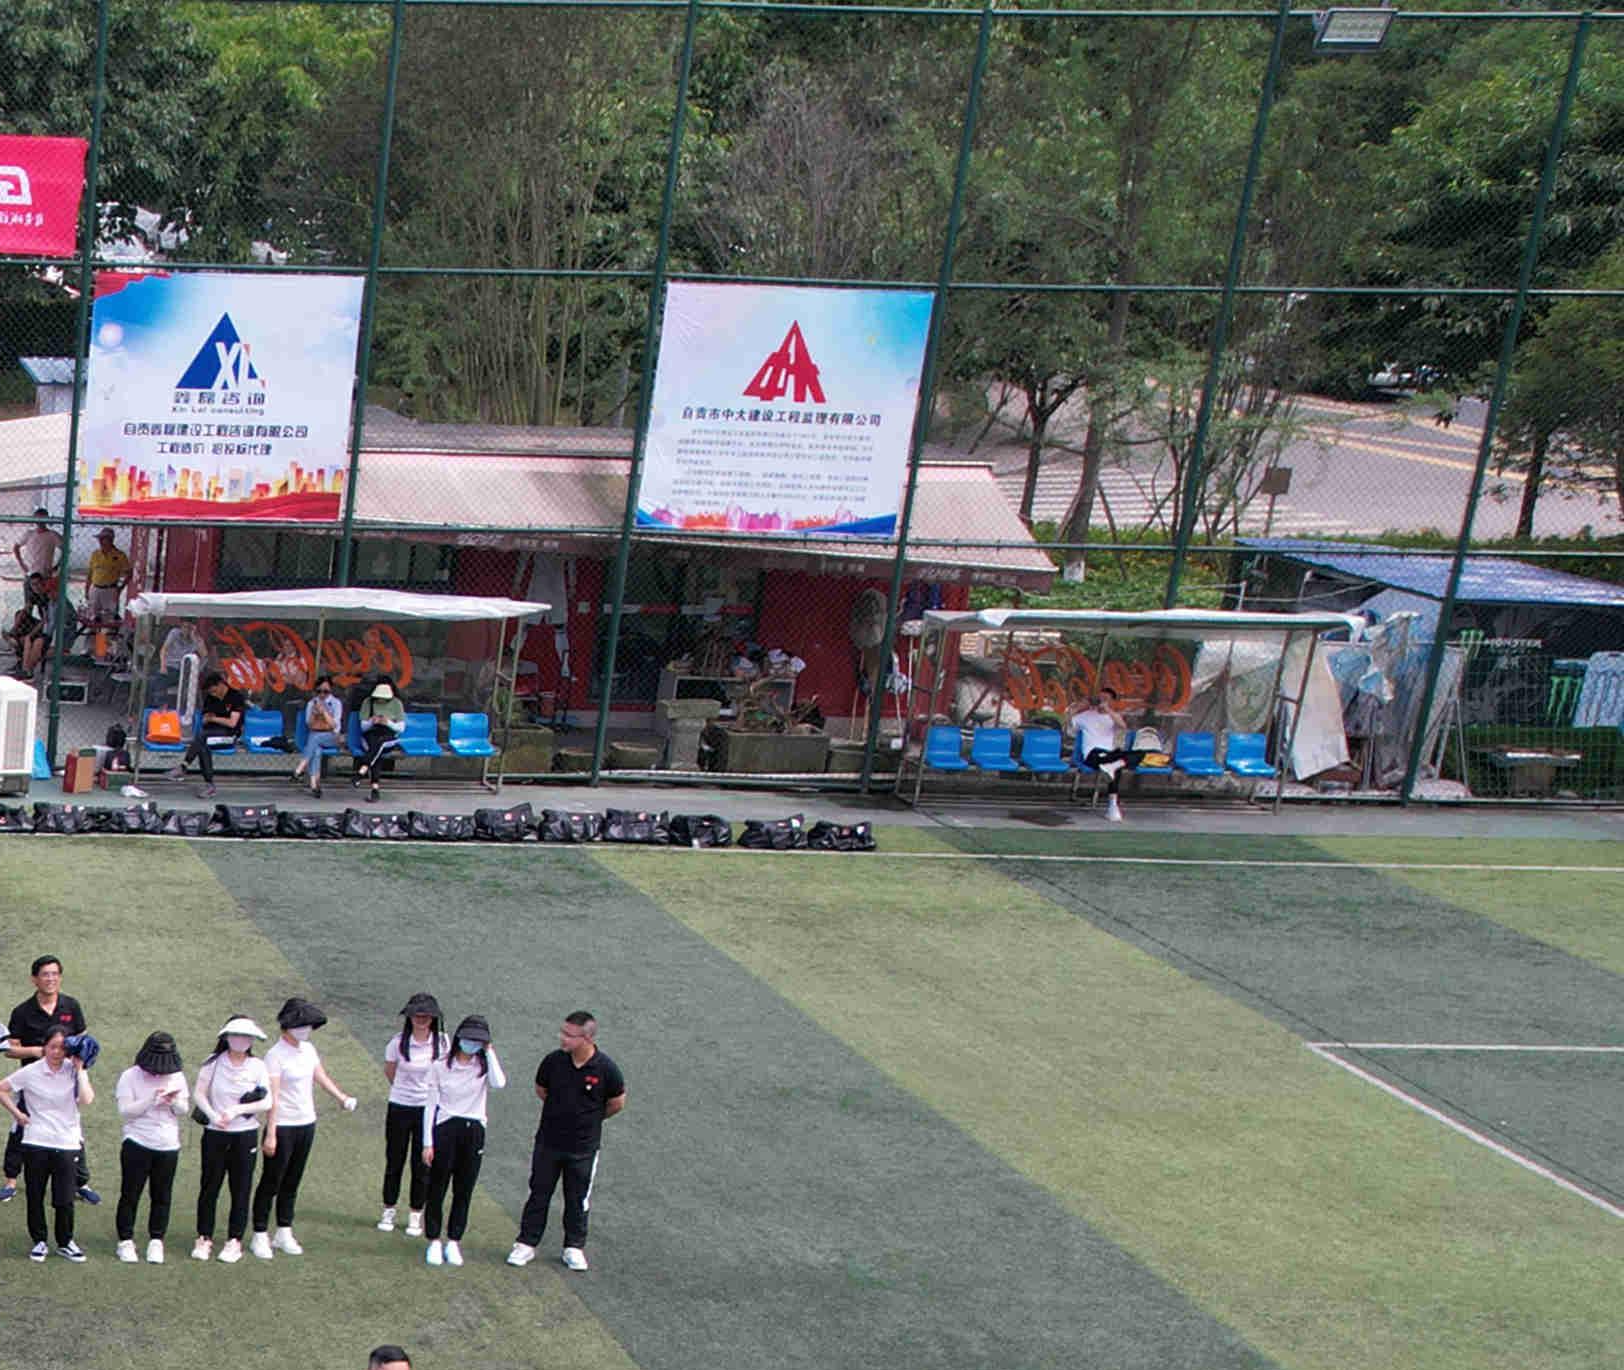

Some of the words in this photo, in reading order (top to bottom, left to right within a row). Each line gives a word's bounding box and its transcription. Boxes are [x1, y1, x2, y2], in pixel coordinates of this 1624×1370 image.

[681, 405, 882, 427] 自贡市中大建设工程监理有限公司
